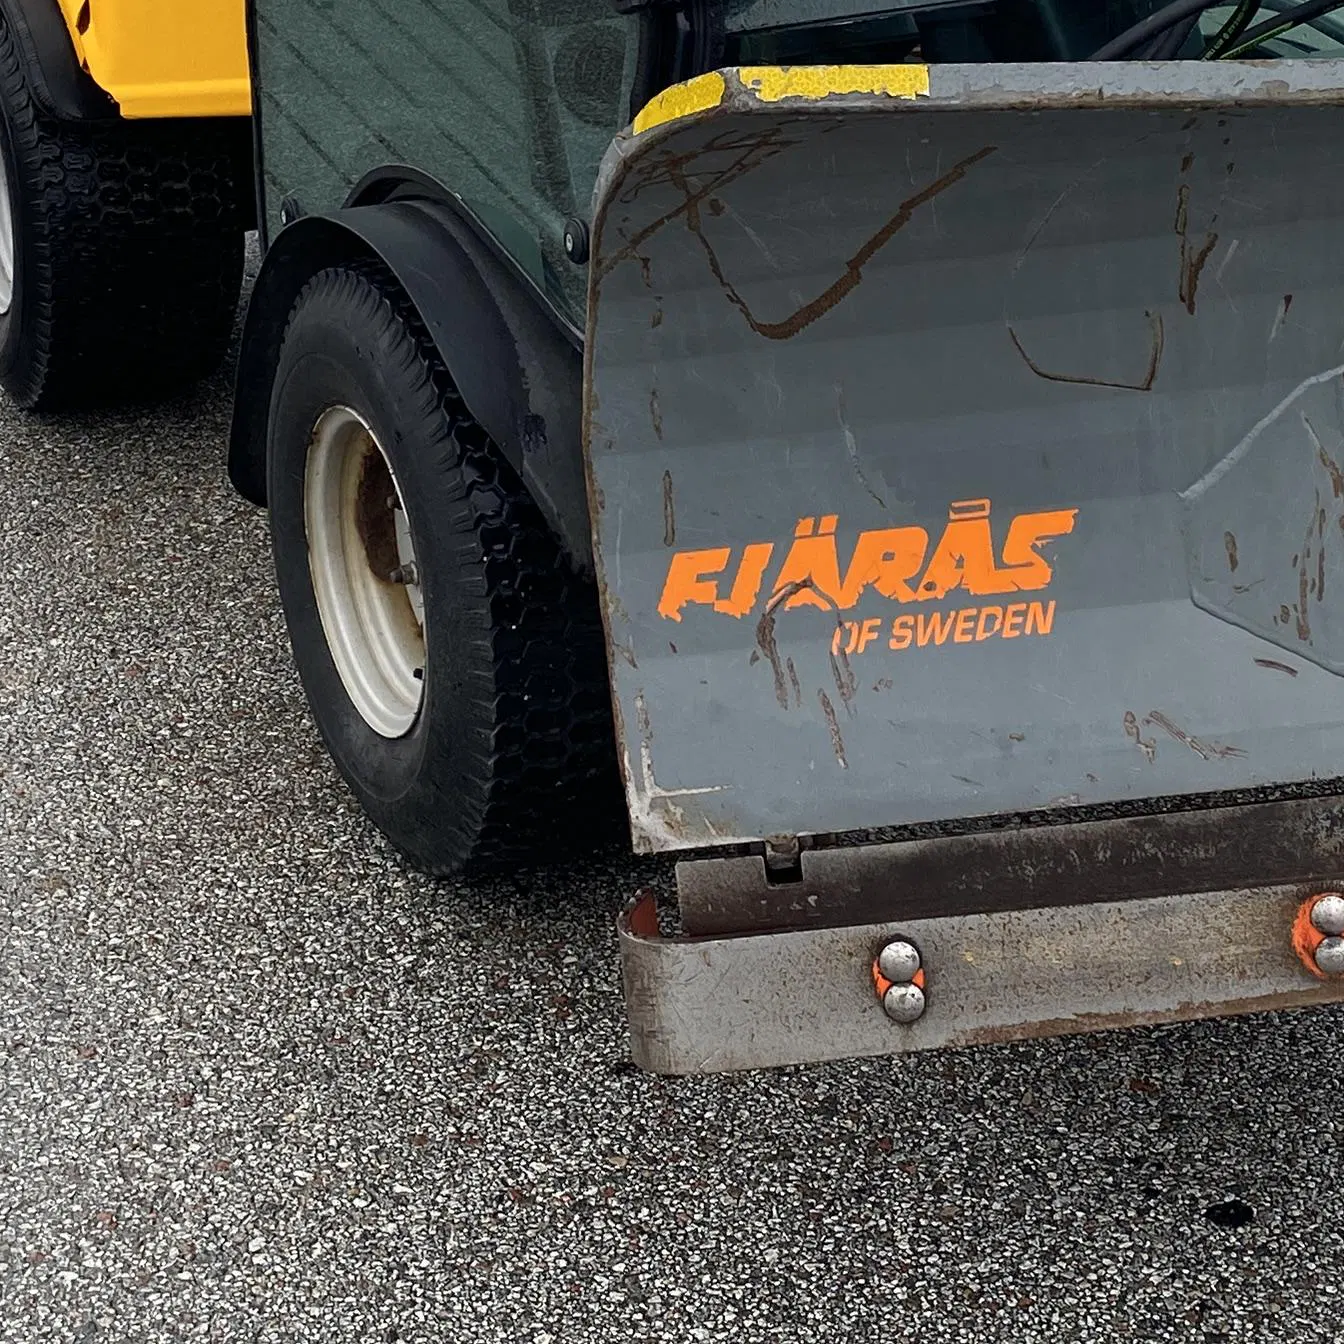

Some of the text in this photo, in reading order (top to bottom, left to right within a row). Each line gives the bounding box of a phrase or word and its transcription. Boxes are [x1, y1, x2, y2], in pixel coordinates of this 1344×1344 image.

[657, 498, 1079, 623] FJÄRÅS
[831, 600, 1057, 659] OF SWEDEN
